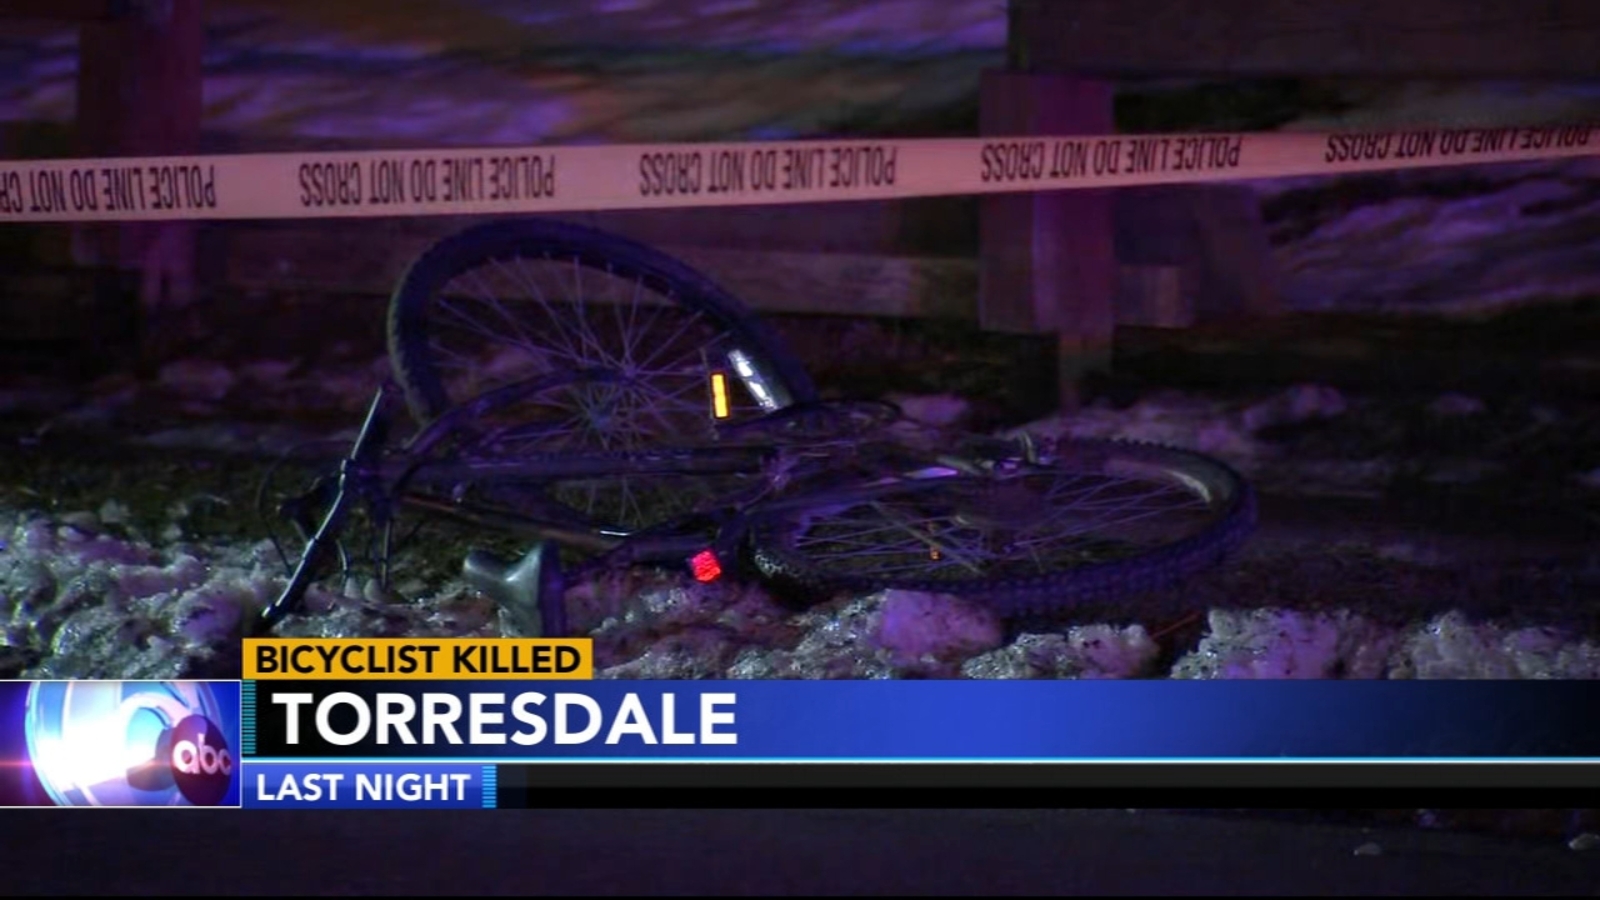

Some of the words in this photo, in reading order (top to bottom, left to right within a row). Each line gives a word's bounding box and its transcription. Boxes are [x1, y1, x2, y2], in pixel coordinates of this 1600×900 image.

[981, 141, 1046, 182] CROSS
[1050, 140, 1089, 178] NOT
[1094, 139, 1122, 174] DO
[1125, 138, 1169, 173] LINE
[1173, 136, 1243, 170] POLICE
[1325, 132, 1391, 163] CROSS
[1394, 130, 1438, 158] NOT
[150, 165, 217, 209] POLICE
[299, 161, 361, 206] CROSS
[369, 159, 404, 204] NOT
[410, 159, 436, 201] DO
[443, 157, 484, 201] LINE
[490, 155, 555, 199] POLICE
[639, 152, 701, 196] CROSS
[707, 150, 743, 193] NOT
[750, 149, 777, 190] DO
[782, 148, 825, 189] LINE
[830, 146, 897, 187] POLICE
[29, 170, 67, 212] NOT
[70, 168, 98, 211] DO
[102, 167, 146, 211] LINE
